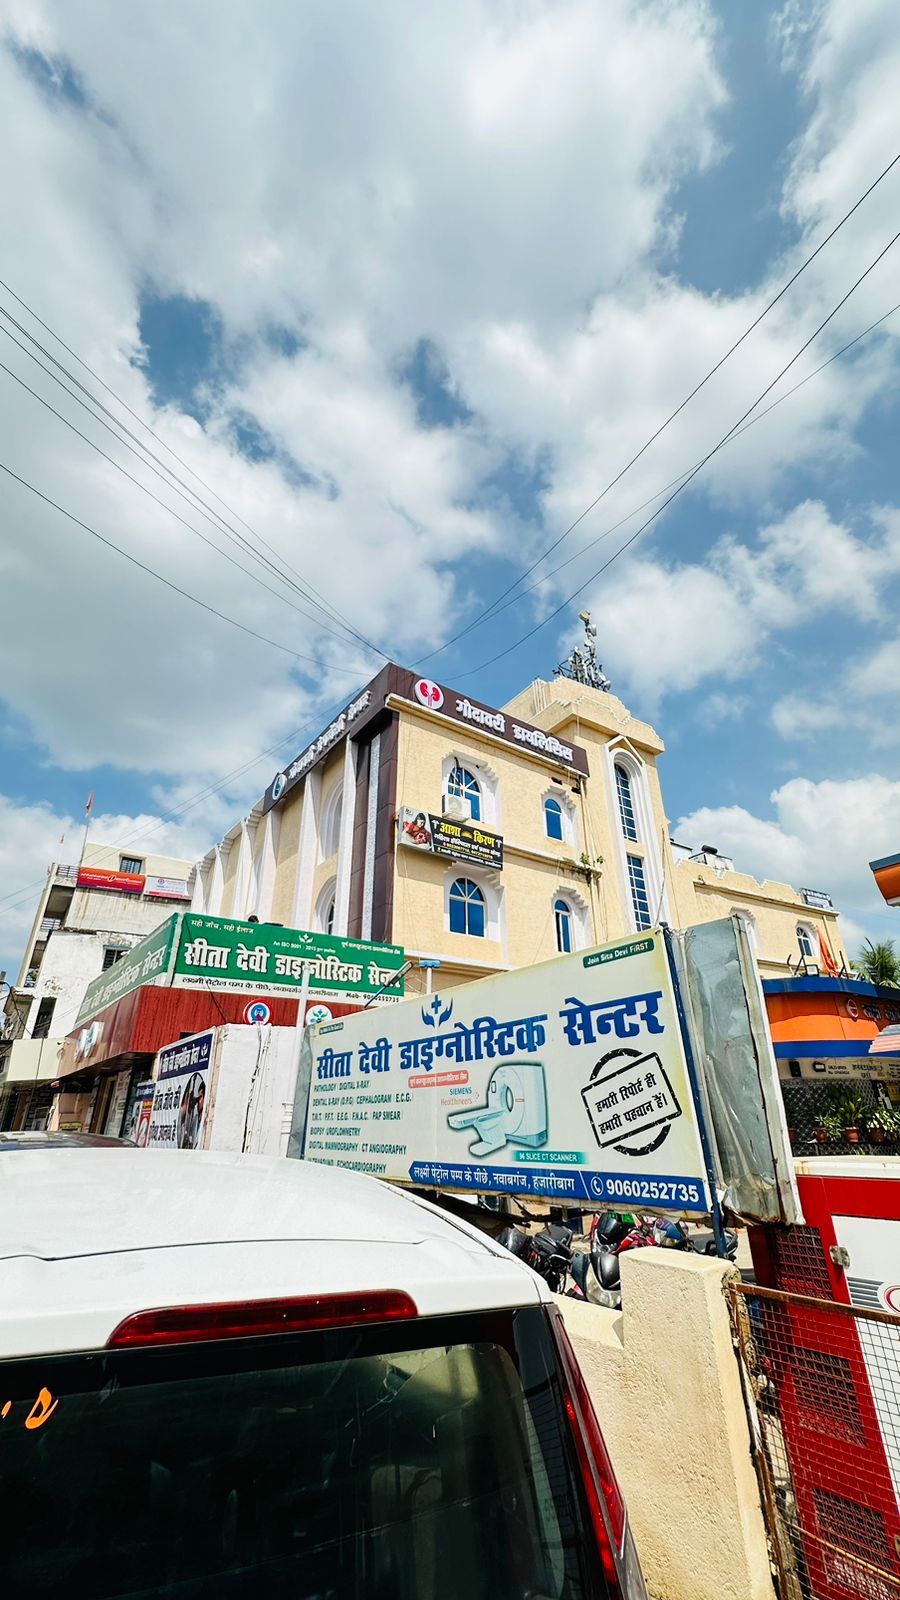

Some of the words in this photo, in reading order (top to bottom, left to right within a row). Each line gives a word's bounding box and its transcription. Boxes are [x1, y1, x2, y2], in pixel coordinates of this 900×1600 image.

[455, 698, 506, 733] गोदावरी
[511, 723, 573, 761] डायलिसिस
[440, 822, 461, 837] आशा
[473, 829, 495, 848] किरण
[191, 919, 203, 928] सही
[223, 924, 235, 932] सही
[184, 938, 231, 969] सीता
[236, 943, 270, 973] देवी
[586, 957, 600, 966] Join
[600, 952, 614, 962] Sita
[614, 948, 629, 958] Devi
[245, 981, 253, 989] के
[317, 1047, 353, 1080] सीता
[358, 1037, 392, 1074] देवी
[398, 1014, 548, 1071] डाइग्नोस्टिक
[559, 990, 665, 1046] सेन्टर
[313, 1083, 336, 1092] PATHOLOGY
[339, 1081, 356, 1091] DIGITAL
[449, 1087, 473, 1096] SIEMENS
[595, 1091, 619, 1113] हमारी
[619, 1077, 644, 1101] रिपोर्ट
[644, 1072, 657, 1088] ही
[312, 1098, 327, 1107] DENTAL
[356, 1093, 392, 1105] CEPHALOGRAM
[395, 1092, 412, 1103] E.C.G.
[441, 1097, 472, 1105] Healthineers
[372, 1111, 382, 1120] PAP
[382, 1110, 401, 1120] SMEAR
[598, 1113, 623, 1134] हमारी
[623, 1100, 655, 1123] पहचान
[310, 1127, 325, 1136] BIOPSY
[309, 1140, 324, 1149] DIGITAL
[361, 1143, 369, 1152] CT
[369, 1143, 407, 1155] ANGIOGRAPHY
[526, 1152, 541, 1160] SLICE
[550, 1153, 578, 1161] SCANNER
[414, 1164, 430, 1179] लक्ष्मी
[431, 1164, 449, 1183] पेट्रोल
[450, 1171, 463, 1181] पम्प
[464, 1168, 472, 1182] के
[532, 1172, 575, 1191] हजारीबाग
[606, 1178, 700, 1203] 9060252735
